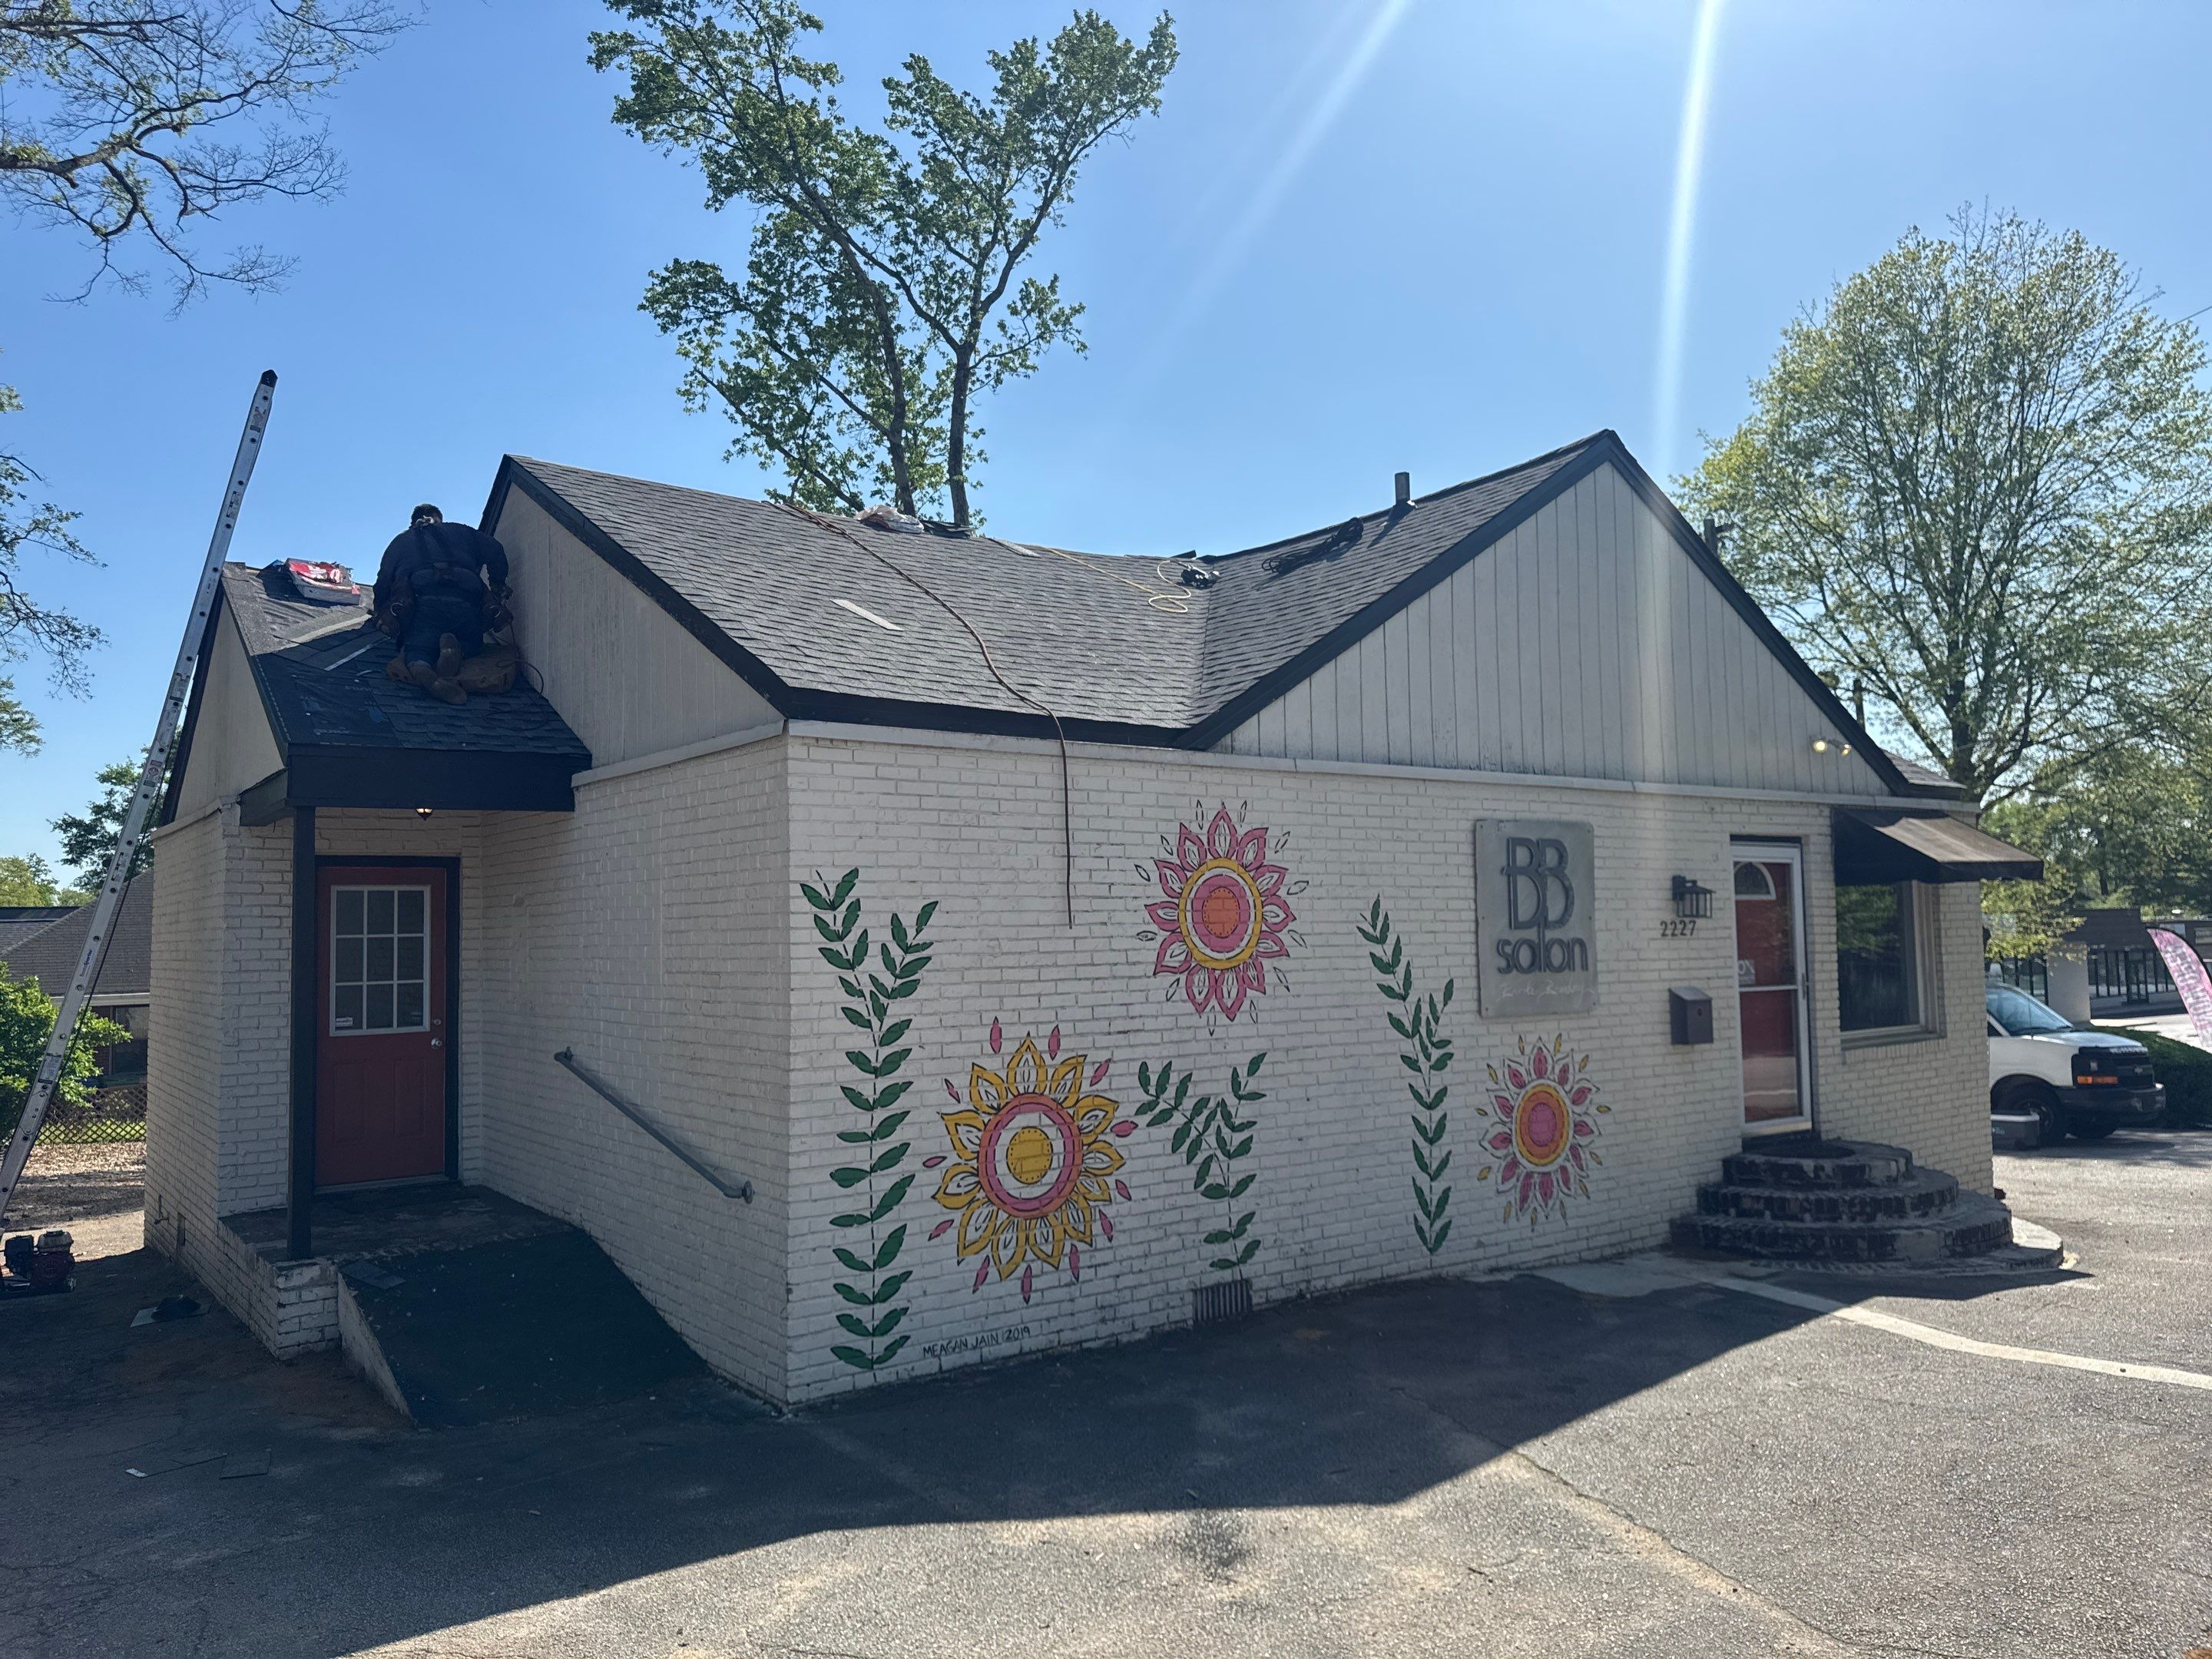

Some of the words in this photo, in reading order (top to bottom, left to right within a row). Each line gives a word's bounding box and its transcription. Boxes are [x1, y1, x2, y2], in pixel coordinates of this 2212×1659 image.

[1502, 837, 1575, 930] BB
[1660, 919, 1697, 937] 2227
[1497, 924, 1588, 974] salon
[923, 1337, 968, 1358] MEAGAN
[971, 1333, 999, 1350] JAIN
[1005, 1326, 1031, 1341] 2019
